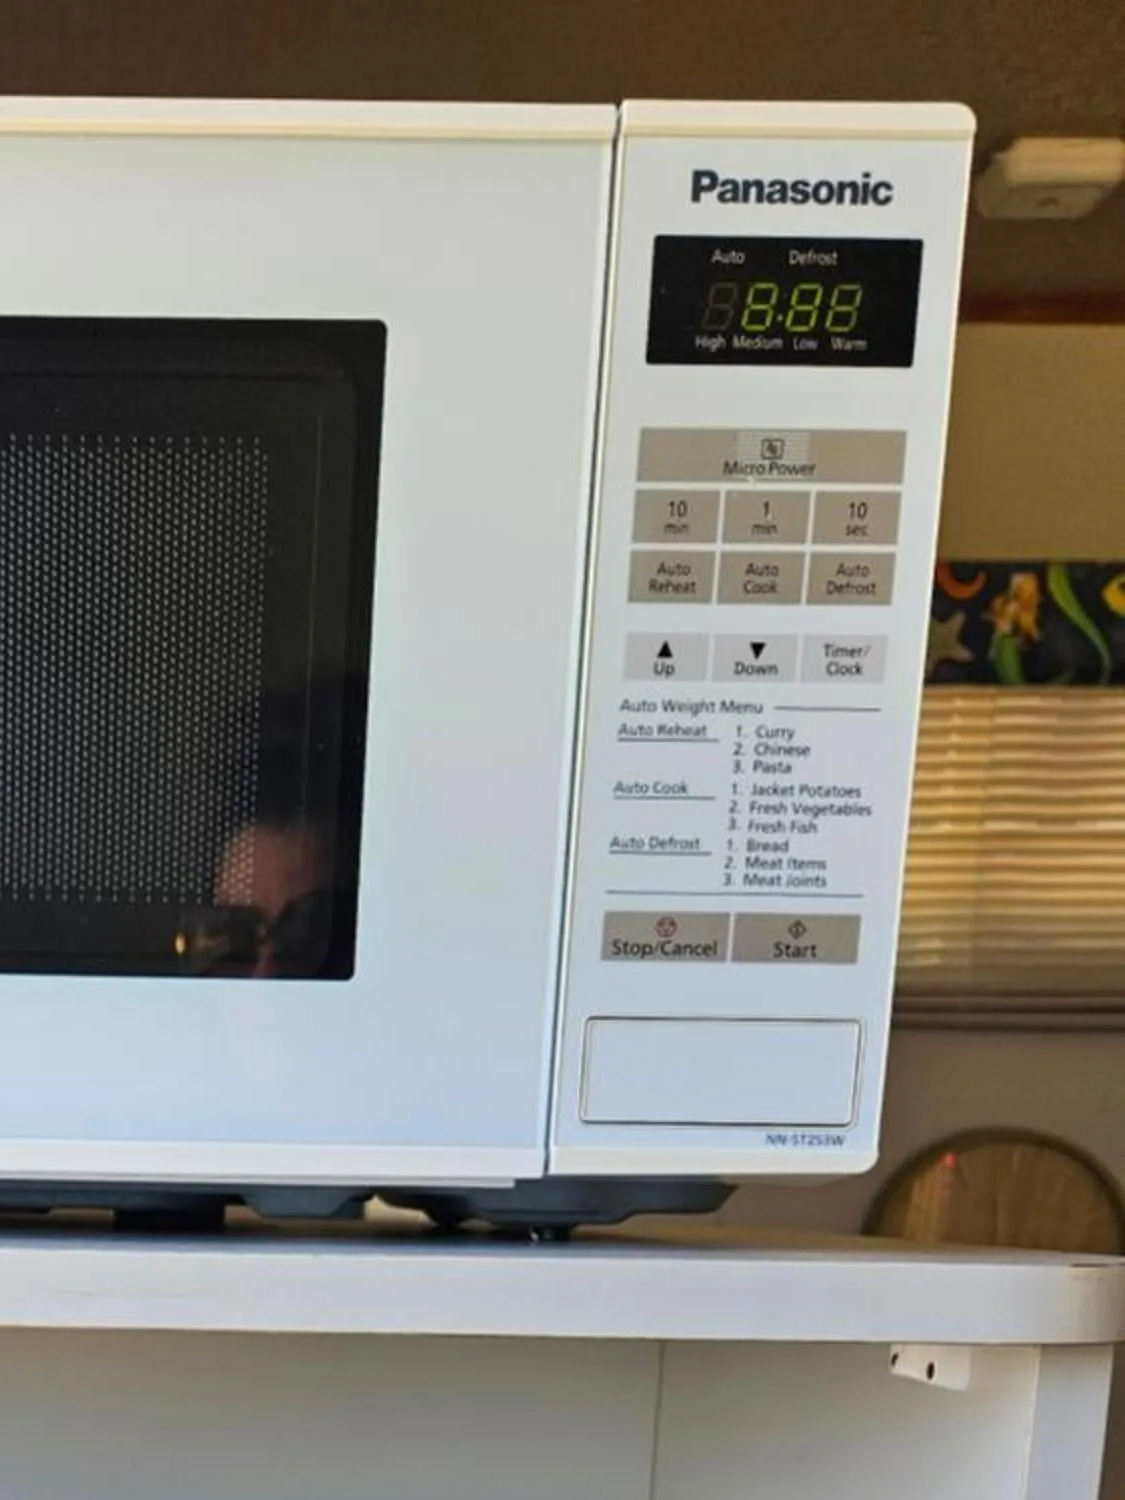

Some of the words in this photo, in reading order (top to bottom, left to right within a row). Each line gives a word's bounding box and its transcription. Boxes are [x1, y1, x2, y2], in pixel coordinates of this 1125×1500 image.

[690, 169, 894, 207] Panasonic
[711, 248, 746, 265] Auto
[788, 249, 838, 266] Defrost
[694, 334, 727, 353] High
[732, 334, 784, 350] Medium
[792, 337, 818, 351] Low
[830, 336, 868, 351] Warm
[722, 458, 768, 476] Micro
[768, 458, 817, 476] Power
[668, 499, 688, 518] 10
[763, 500, 770, 517] 1
[849, 501, 868, 520] 10
[663, 522, 689, 535] min
[751, 523, 778, 536] min
[845, 524, 868, 537] sec
[656, 561, 692, 577] Auto
[744, 562, 779, 577] Auto
[835, 562, 870, 578] Auto
[648, 578, 697, 594] Reheat
[742, 579, 778, 595] Cook
[825, 579, 877, 596] Defrost
[823, 641, 872, 659] Timer/
[653, 658, 676, 678] Up
[733, 659, 779, 676] Down
[825, 660, 863, 677] Clock
[619, 698, 658, 713] Auto
[661, 699, 716, 718] Weight
[719, 699, 764, 715] Menu
[617, 722, 654, 738] Auto
[655, 723, 708, 738] Reheat
[754, 724, 796, 744] Curry
[732, 741, 748, 757] 2.
[753, 742, 811, 757] Chinese
[732, 758, 745, 775] 3.
[752, 759, 793, 775] Pasta
[613, 780, 651, 796] Auto
[651, 781, 690, 797] Cook
[751, 783, 795, 797] Jacket
[798, 783, 862, 799] Potatoes
[728, 799, 742, 815] 2.
[748, 800, 788, 815] Fresh
[791, 802, 873, 821] Vegetables
[747, 819, 787, 835] Fresh
[789, 816, 819, 835] Fish
[609, 835, 647, 852] Auto
[647, 835, 702, 852] Defrost
[746, 838, 790, 853] Bread
[723, 855, 737, 870] 2.
[744, 855, 784, 870] Meat
[786, 857, 827, 871] Items
[742, 872, 782, 887] Meat
[785, 874, 828, 888] Joints
[611, 938, 718, 960] Stop/Cancel
[772, 940, 817, 959] Start
